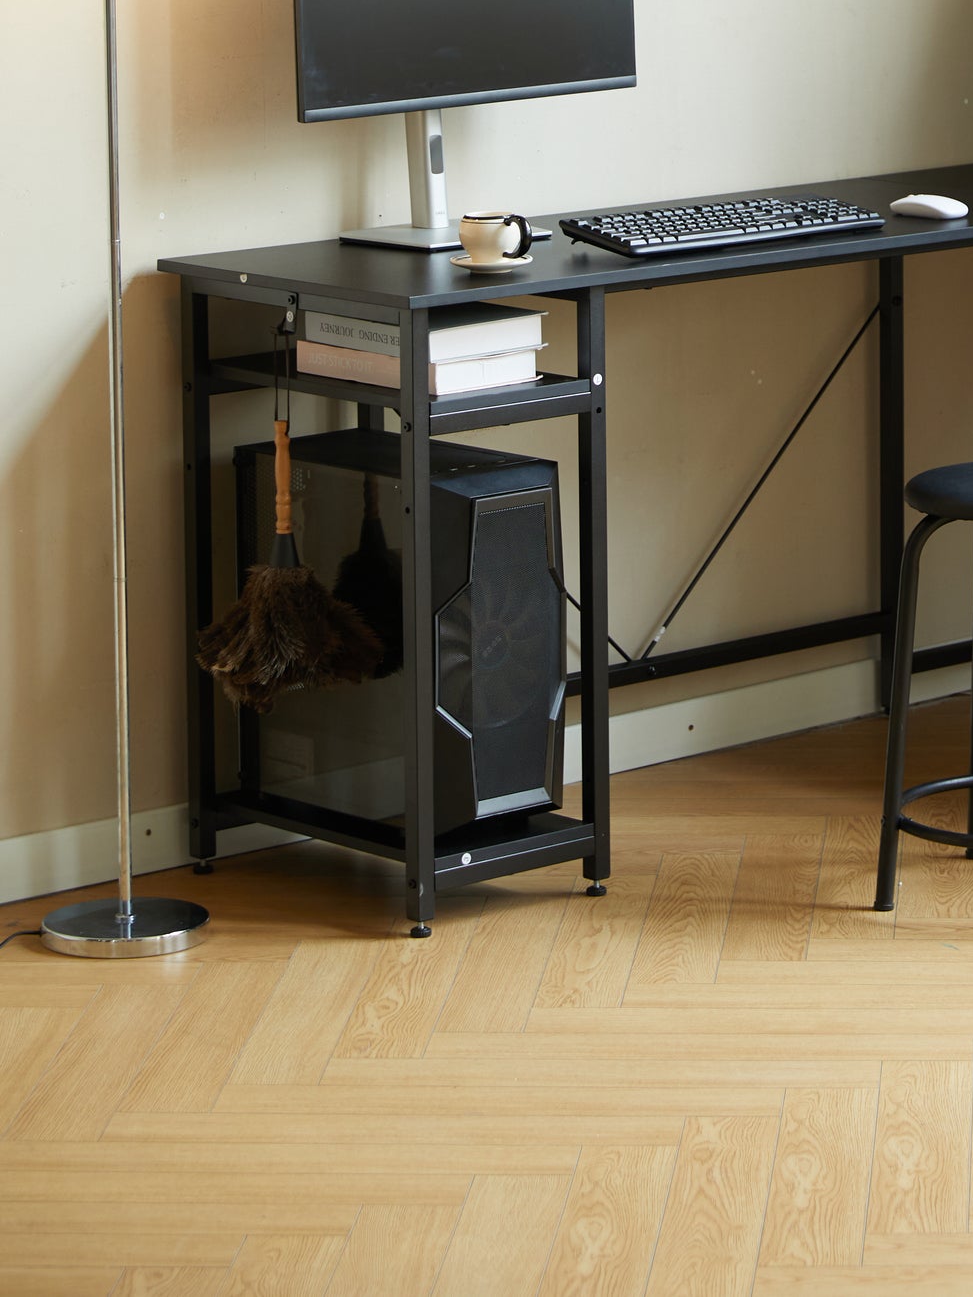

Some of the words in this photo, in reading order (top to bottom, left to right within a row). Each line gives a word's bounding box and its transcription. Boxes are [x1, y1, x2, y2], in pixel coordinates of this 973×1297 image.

[320, 322, 354, 338] JOURNEY
[358, 329, 389, 346] ENDING
[308, 352, 329, 367] JUST
